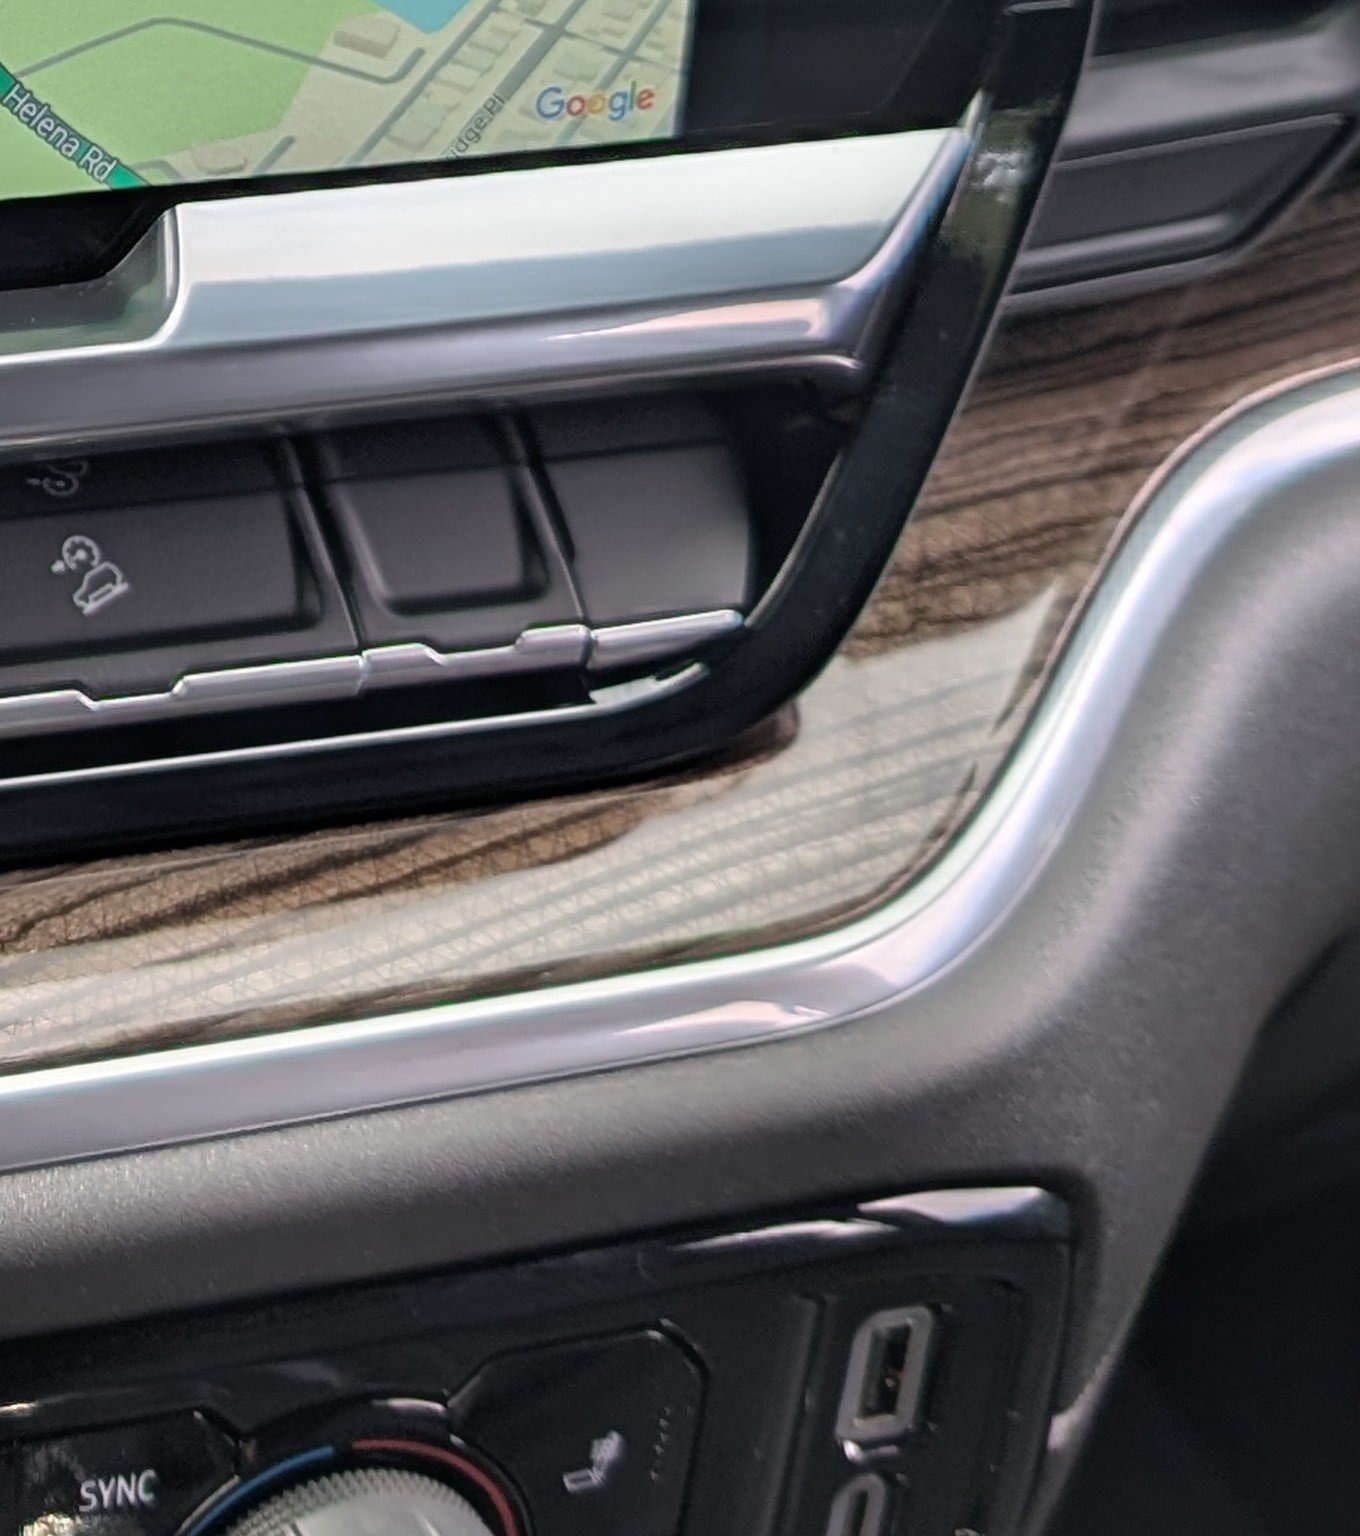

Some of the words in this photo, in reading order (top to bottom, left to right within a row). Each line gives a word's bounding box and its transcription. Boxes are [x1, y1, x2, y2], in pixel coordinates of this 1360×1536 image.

[535, 80, 655, 122] Google
[2, 83, 80, 158] Helena
[79, 145, 118, 183] Rd
[79, 1469, 156, 1514] SYNC
